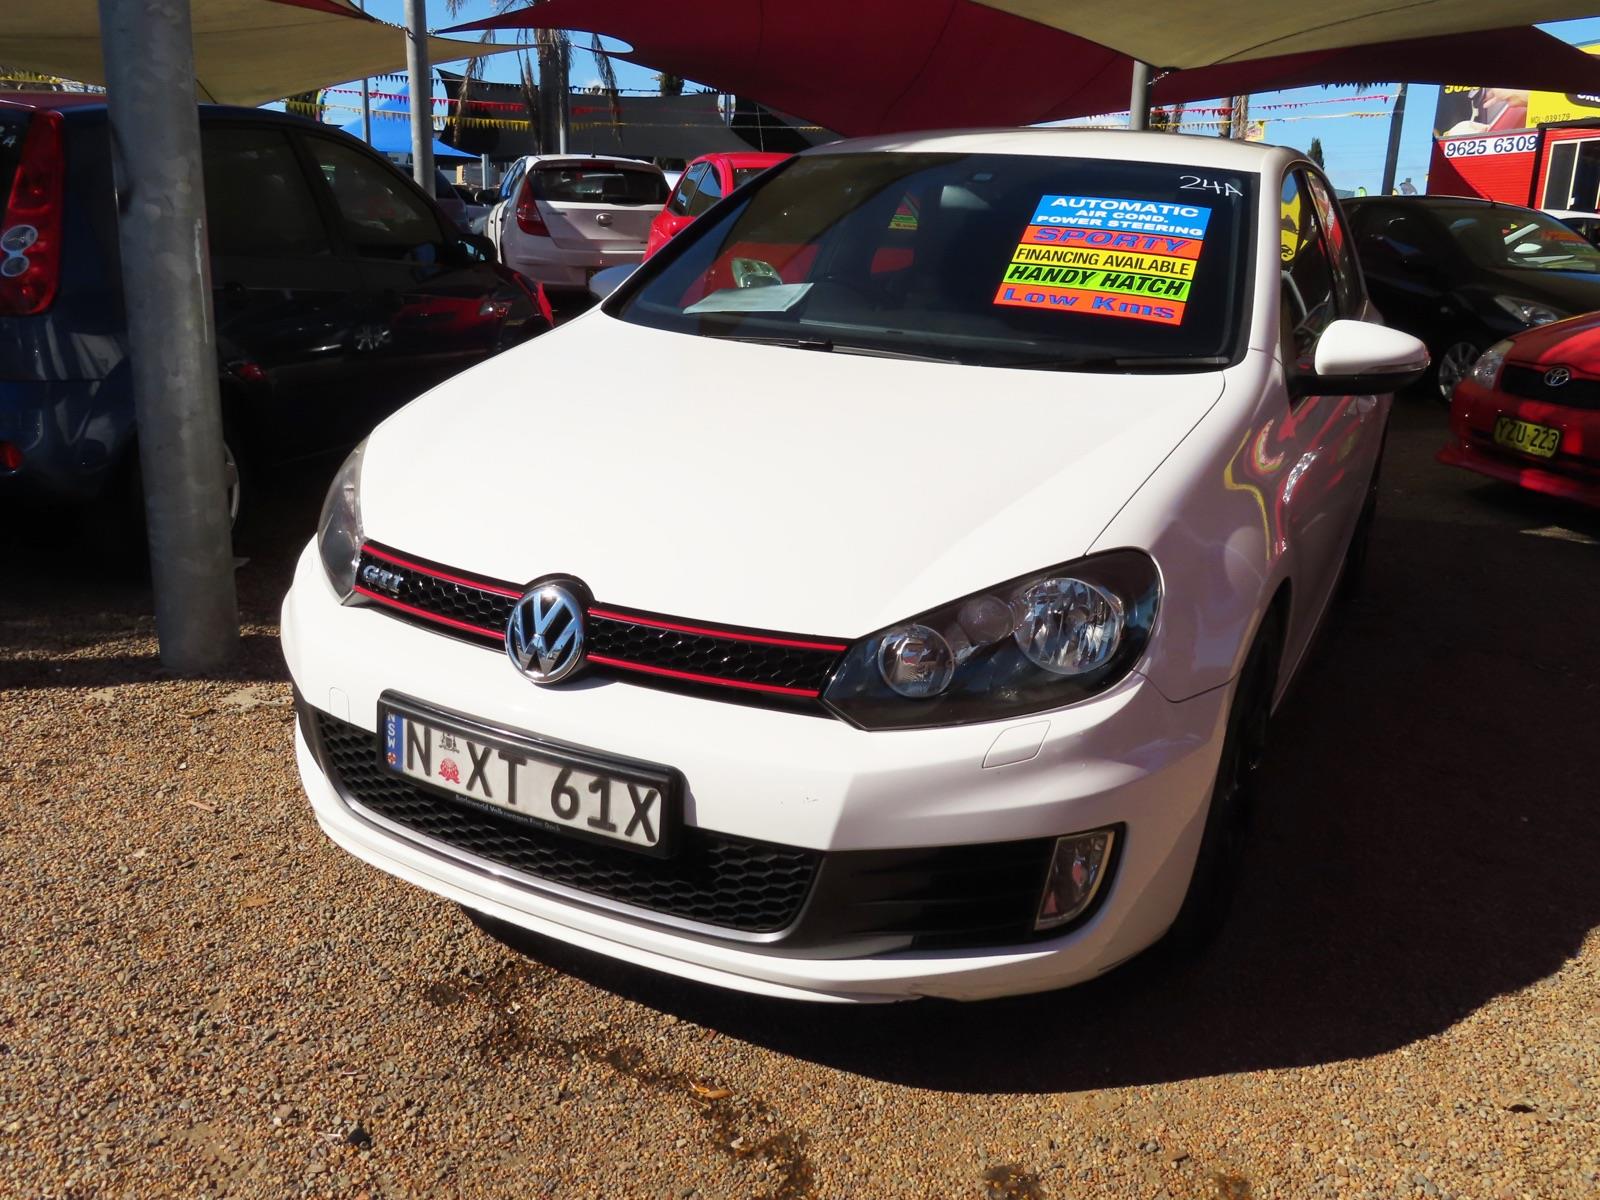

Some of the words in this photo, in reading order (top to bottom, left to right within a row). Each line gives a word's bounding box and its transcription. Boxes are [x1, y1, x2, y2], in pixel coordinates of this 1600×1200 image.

[1446, 140, 1487, 157] 9625
[1493, 136, 1538, 154] 6309
[1179, 175, 1244, 198] 24A
[1051, 197, 1199, 218] AUTOMATIC
[1075, 209, 1108, 219] AIR
[1112, 212, 1168, 223] COND.
[1036, 215, 1102, 227] POWER
[1107, 221, 1203, 236] STEERING
[1033, 228, 1190, 252] SPORTY
[1016, 247, 1099, 266] FINANCING
[1103, 255, 1191, 276] AVAILABLE
[1008, 266, 1097, 286] HANDY
[1100, 273, 1187, 297] HATCH
[363, 564, 404, 593] GTI
[550, 767, 659, 844] 61X
